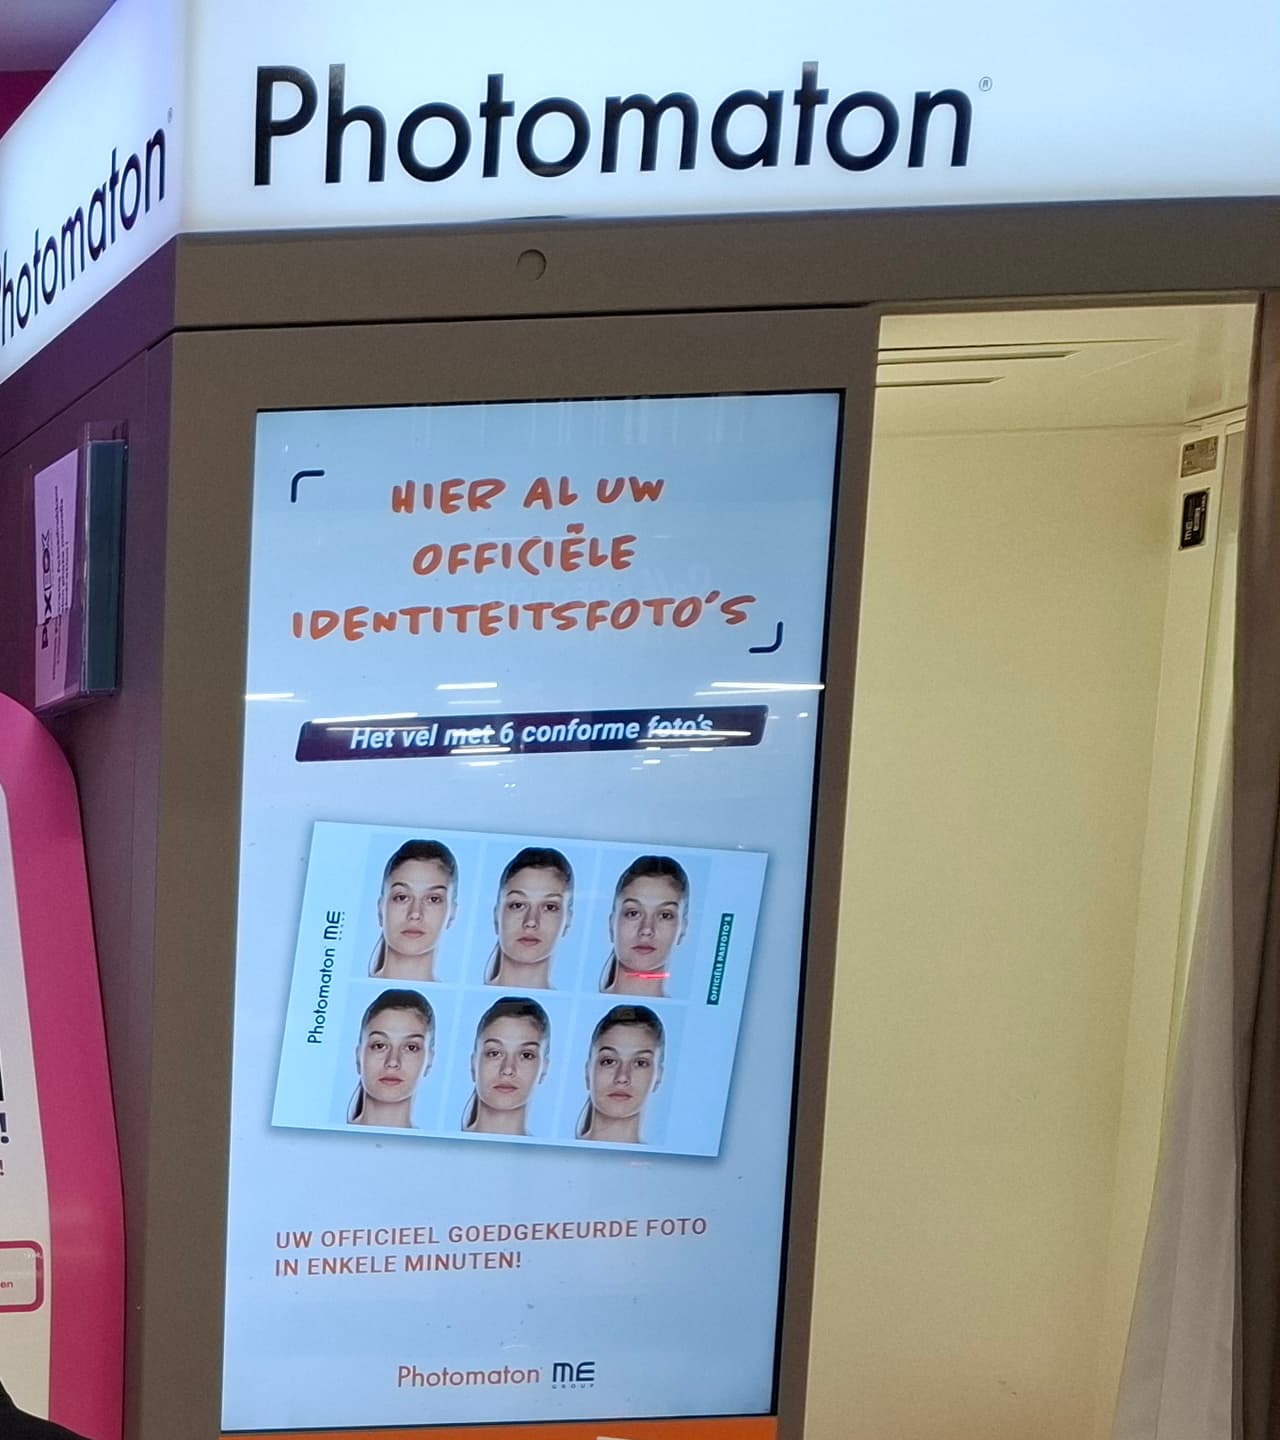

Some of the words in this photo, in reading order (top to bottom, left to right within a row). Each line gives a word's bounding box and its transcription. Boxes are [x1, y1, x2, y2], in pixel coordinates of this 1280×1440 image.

[253, 60, 974, 187] Photomaton
[391, 476, 506, 515] HIER
[523, 476, 579, 510] AL
[596, 475, 665, 504] UW
[412, 522, 637, 577] OFFICIËLE
[292, 590, 758, 643] IDENTITEITSFOTO'S
[350, 725, 396, 752] Het
[400, 723, 436, 748] vel
[444, 724, 494, 746] met
[500, 721, 514, 745] 6
[521, 716, 640, 745] conforme
[647, 712, 713, 740] foto's
[307, 948, 336, 1043] Photomaton
[276, 1231, 312, 1250] UW
[320, 1226, 440, 1248] OFFICIEEL
[448, 1220, 638, 1245] GOEDGEKEURDE
[645, 1217, 707, 1237] FOTO
[275, 1258, 299, 1277] IN
[307, 1254, 397, 1275] ENKELE
[404, 1250, 522, 1273] MINUTEN!
[397, 1364, 539, 1388] Photomaton
